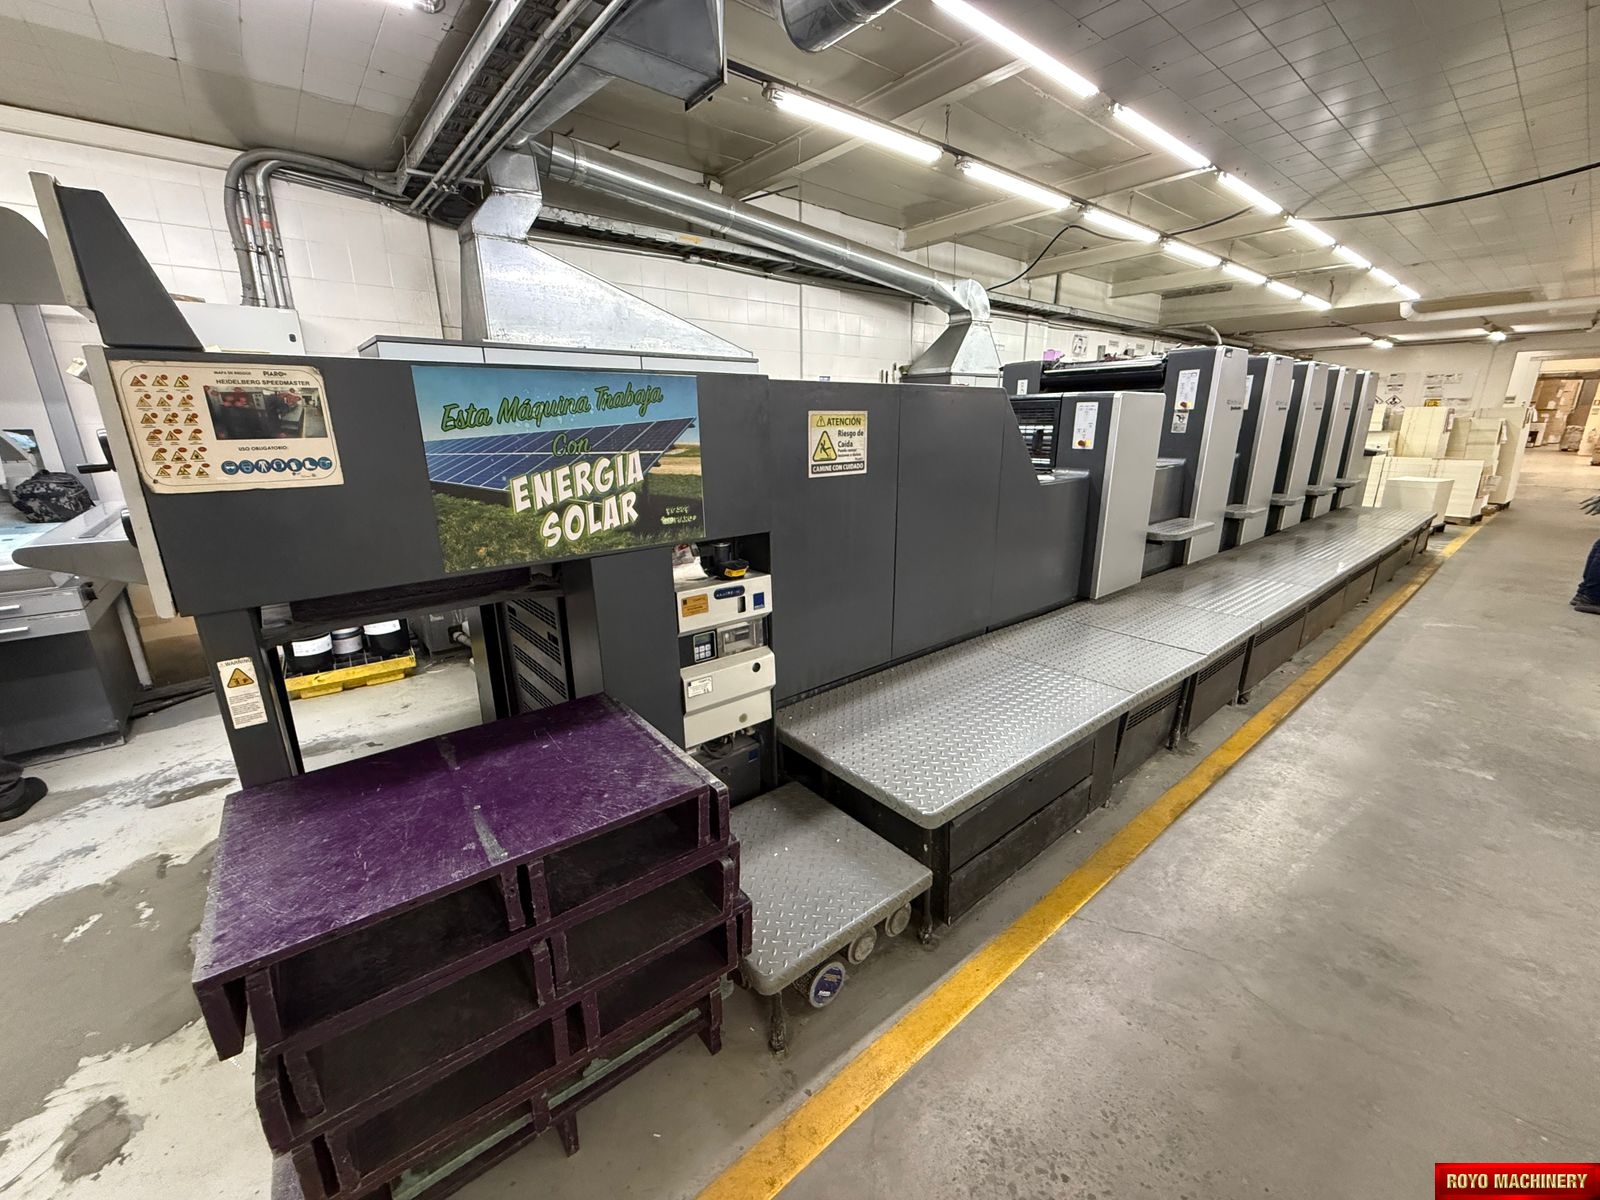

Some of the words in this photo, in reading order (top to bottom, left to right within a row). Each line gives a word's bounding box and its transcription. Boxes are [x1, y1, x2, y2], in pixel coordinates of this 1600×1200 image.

[440, 403, 493, 433] Esta
[497, 395, 591, 427] Máquina
[595, 382, 664, 417] Trabaja
[827, 416, 861, 426] ATENCIÓN
[552, 433, 592, 457] Con
[838, 430, 856, 439] Riesgo
[812, 465, 832, 473] CAMINE
[843, 463, 864, 471] CUIDADO
[510, 450, 644, 514] ENERGIA
[541, 491, 639, 548] SOLAR
